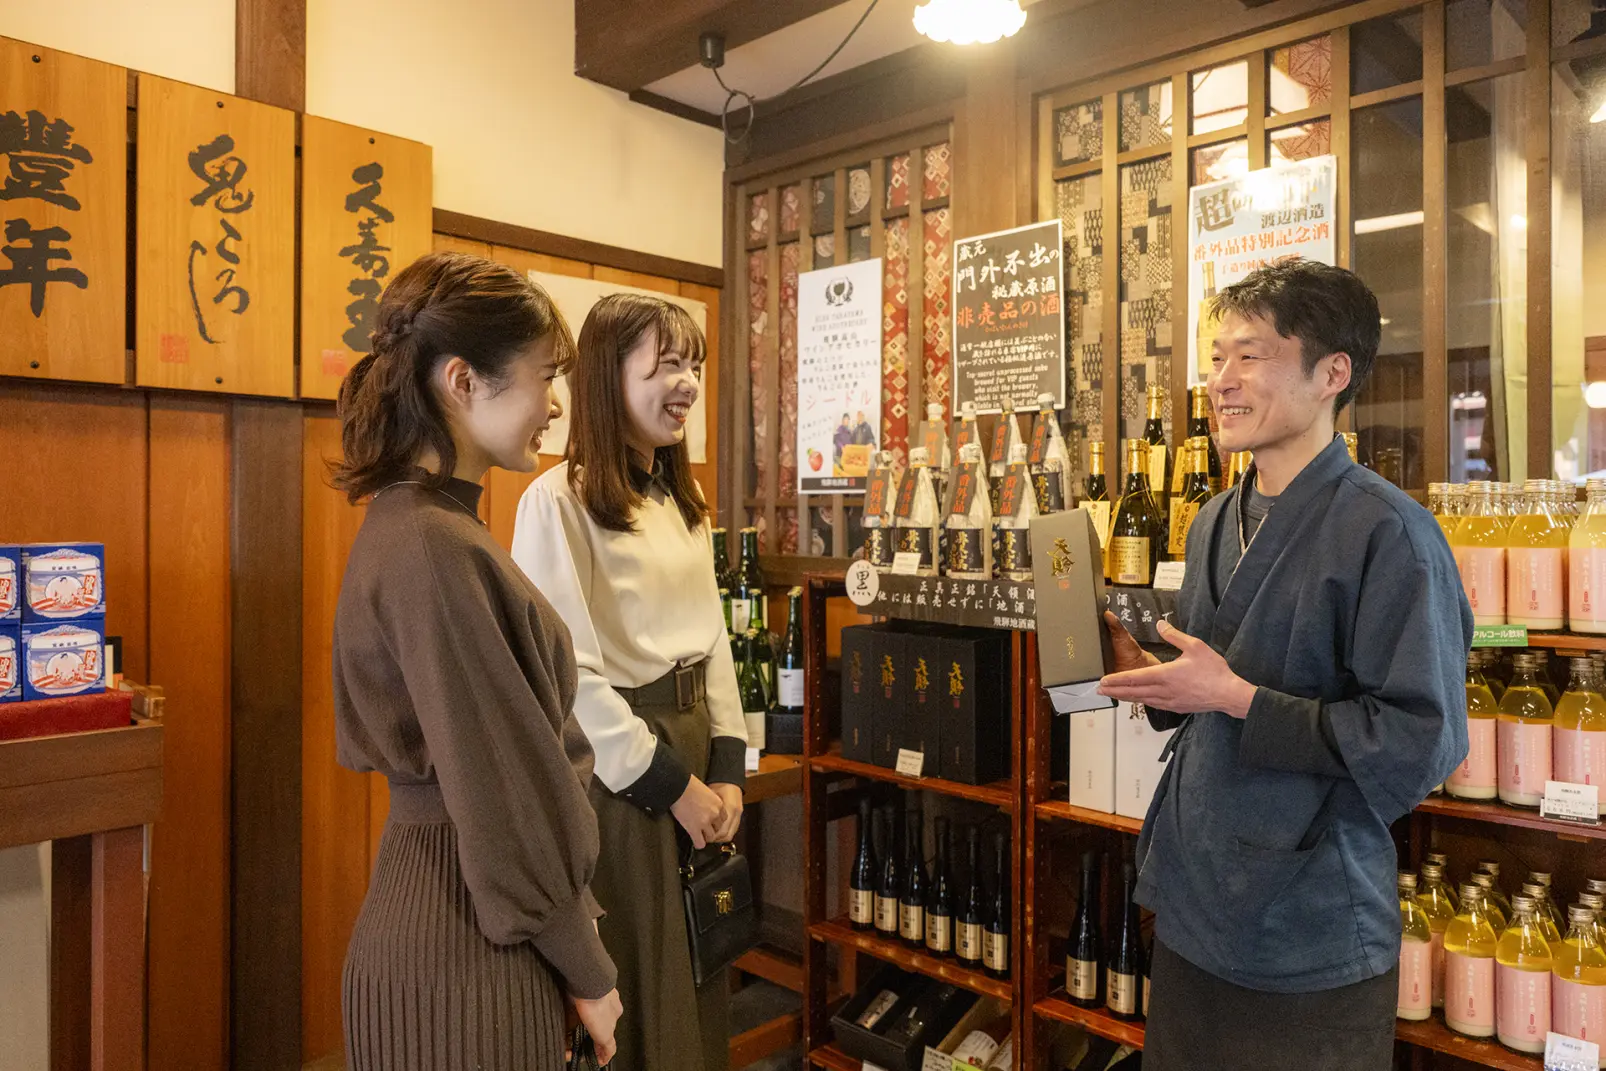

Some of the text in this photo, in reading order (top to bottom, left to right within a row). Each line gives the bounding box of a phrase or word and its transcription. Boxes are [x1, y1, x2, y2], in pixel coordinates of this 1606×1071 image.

[187, 134, 253, 344] 鬼ころし
[958, 240, 986, 262] 蔵元
[1194, 221, 1329, 262] 番外品特別記念酒
[957, 243, 1059, 293] 門外不出の
[991, 275, 1056, 300] 秘蔵原酒
[957, 294, 1060, 328] 非売品の酒
